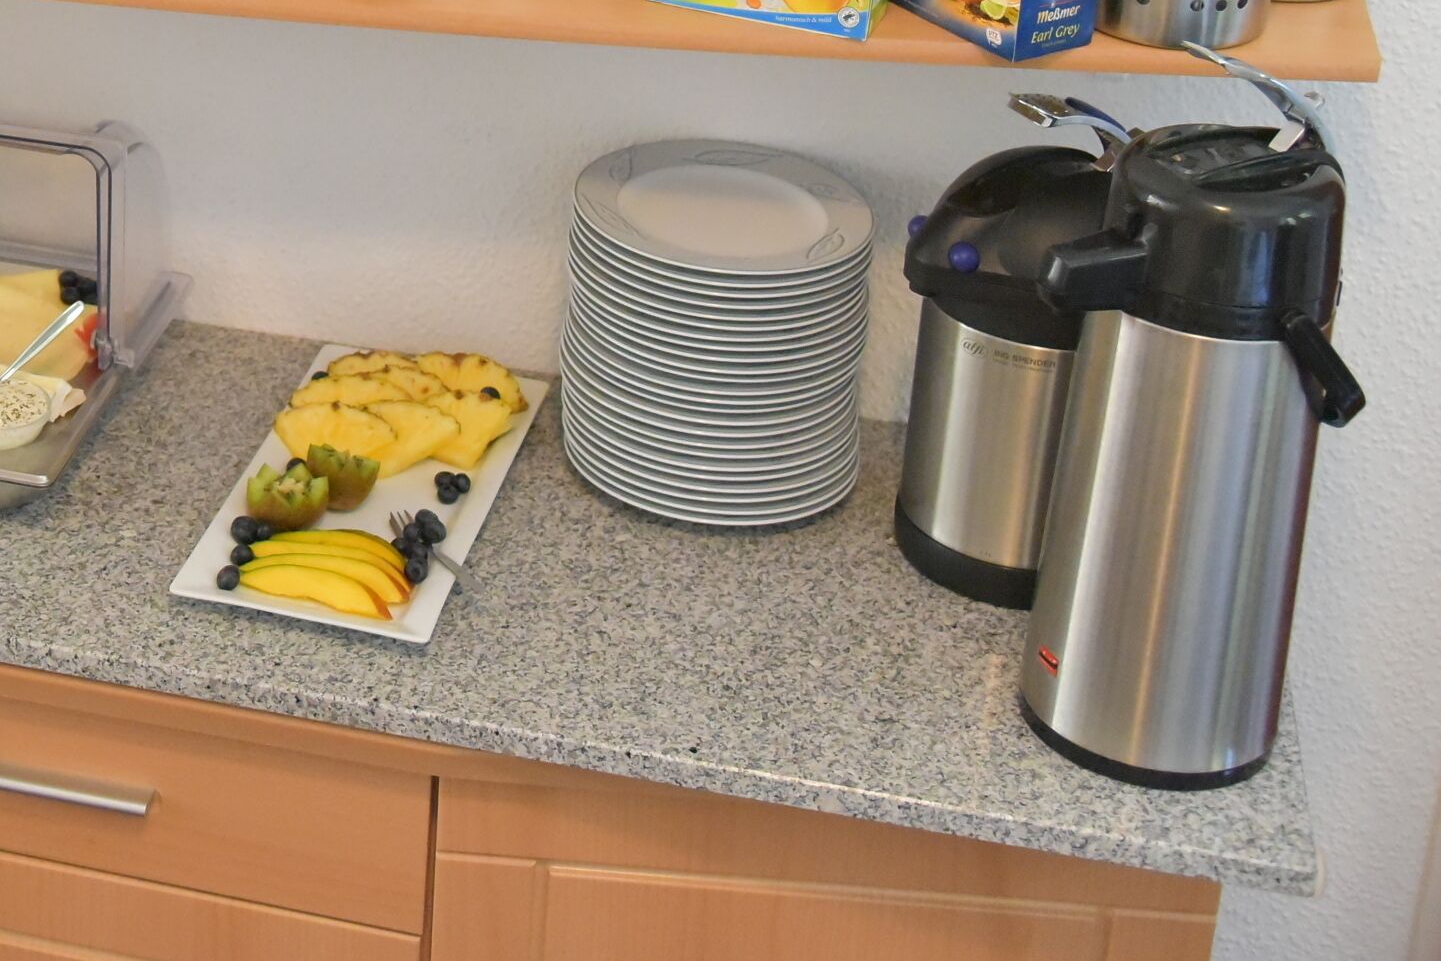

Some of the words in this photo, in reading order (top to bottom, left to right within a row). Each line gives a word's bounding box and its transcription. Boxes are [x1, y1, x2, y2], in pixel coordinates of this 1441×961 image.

[1037, 4, 1081, 25] Meßmer
[1031, 27, 1054, 44] Earl
[1055, 23, 1081, 39] Grey
